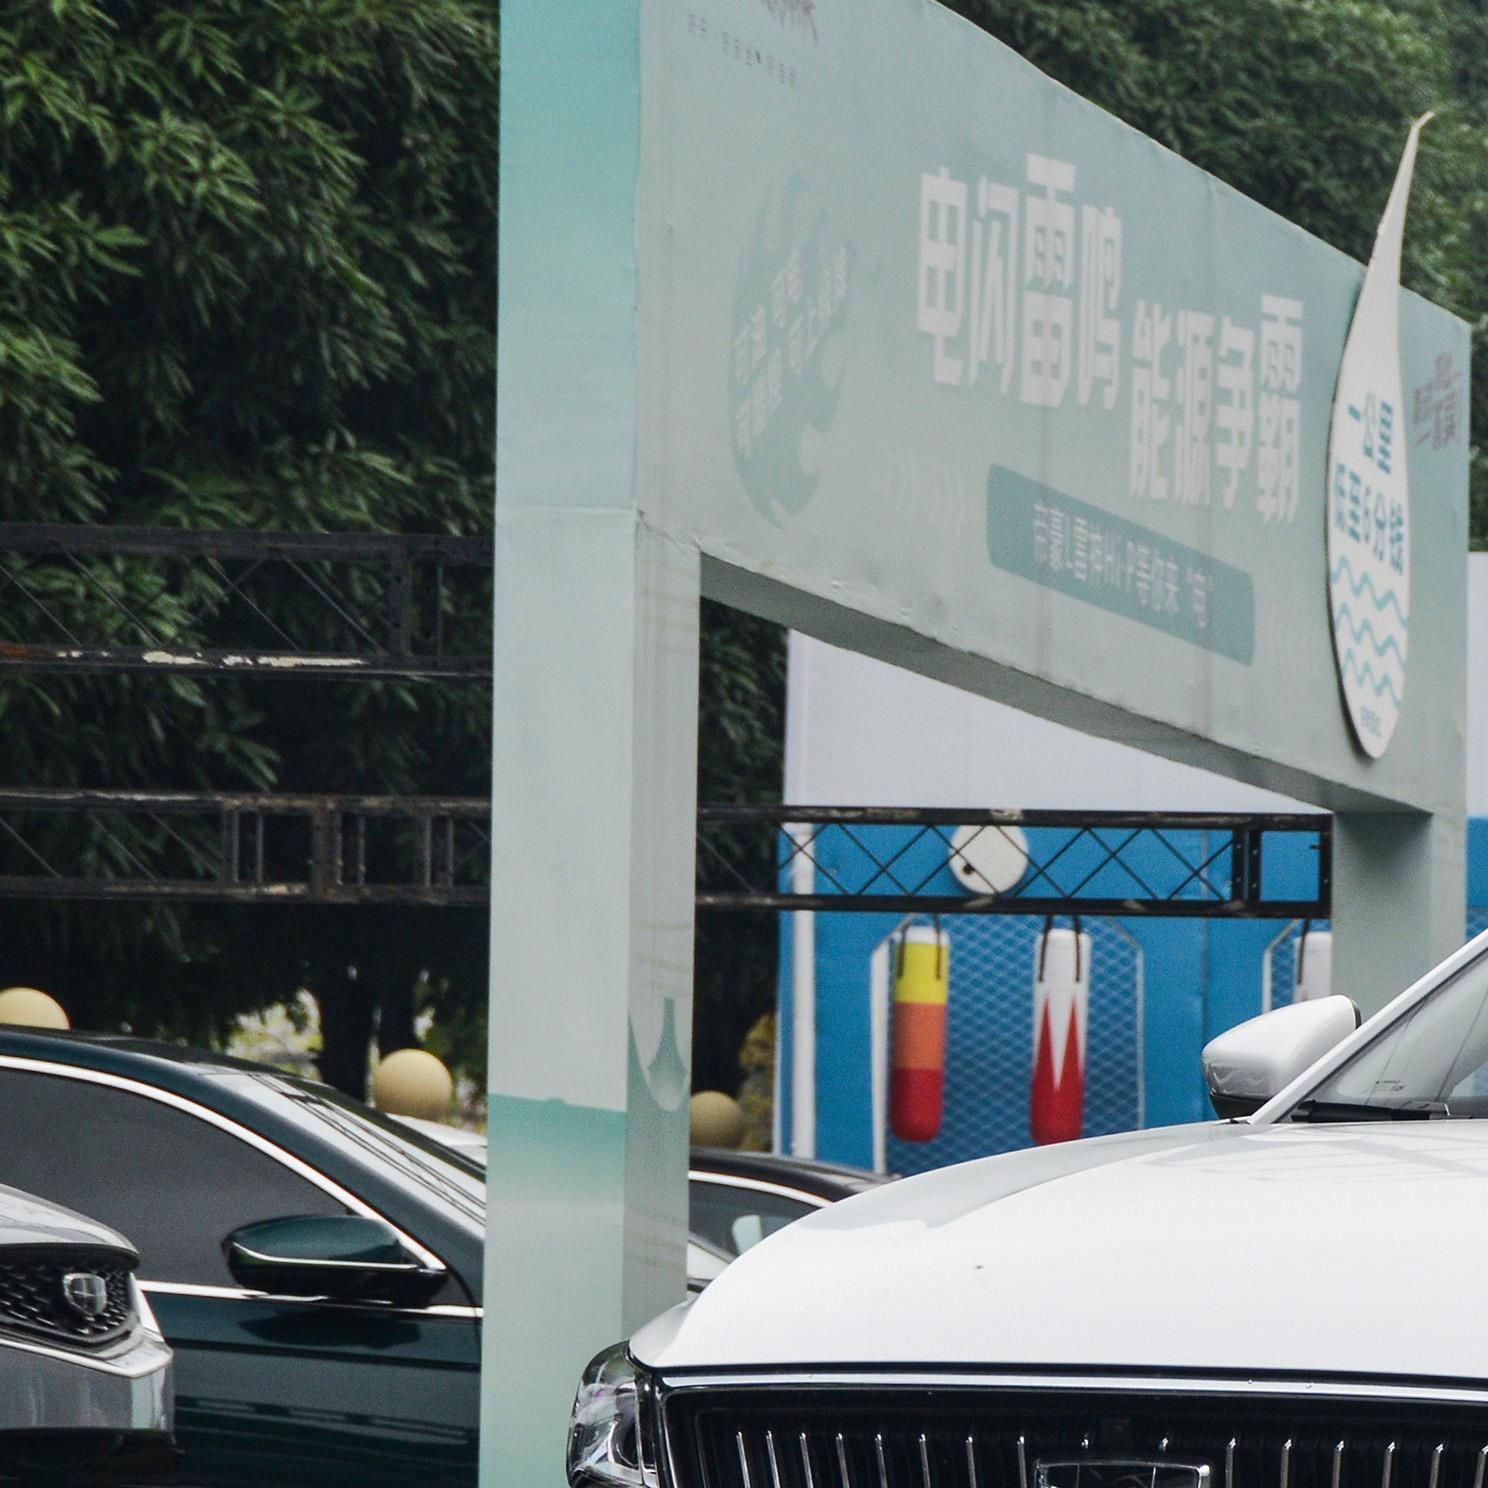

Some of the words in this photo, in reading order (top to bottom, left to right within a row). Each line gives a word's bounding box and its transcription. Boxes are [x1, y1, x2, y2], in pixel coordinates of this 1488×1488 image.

[916, 153, 1122, 411] 电闪雷鸣
[1130, 293, 1302, 524] 能源争霸
